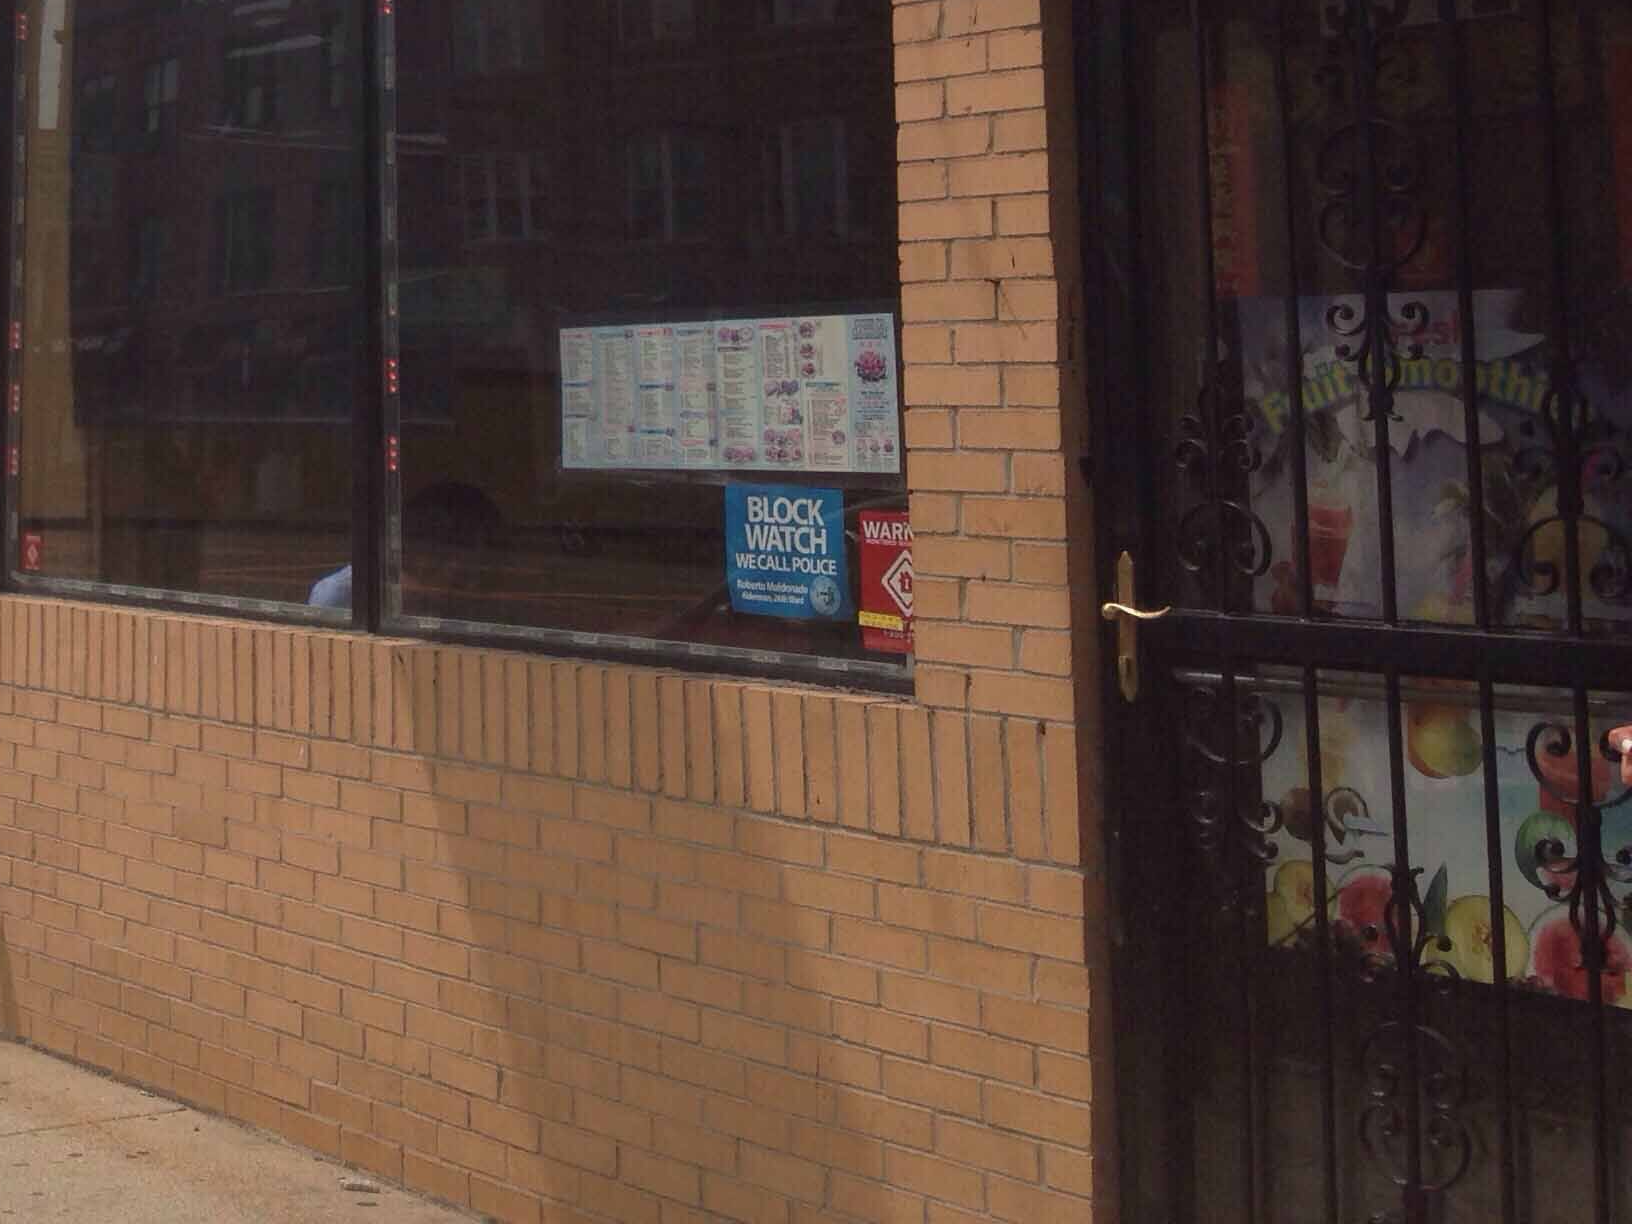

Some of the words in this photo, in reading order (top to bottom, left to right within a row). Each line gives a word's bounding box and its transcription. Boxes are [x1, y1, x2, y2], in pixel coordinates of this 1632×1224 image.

[746, 495, 825, 526] BLOCK
[744, 523, 828, 555] WATCH
[735, 552, 758, 569] WE
[758, 553, 791, 572] CALL
[792, 556, 838, 575] POLICE
